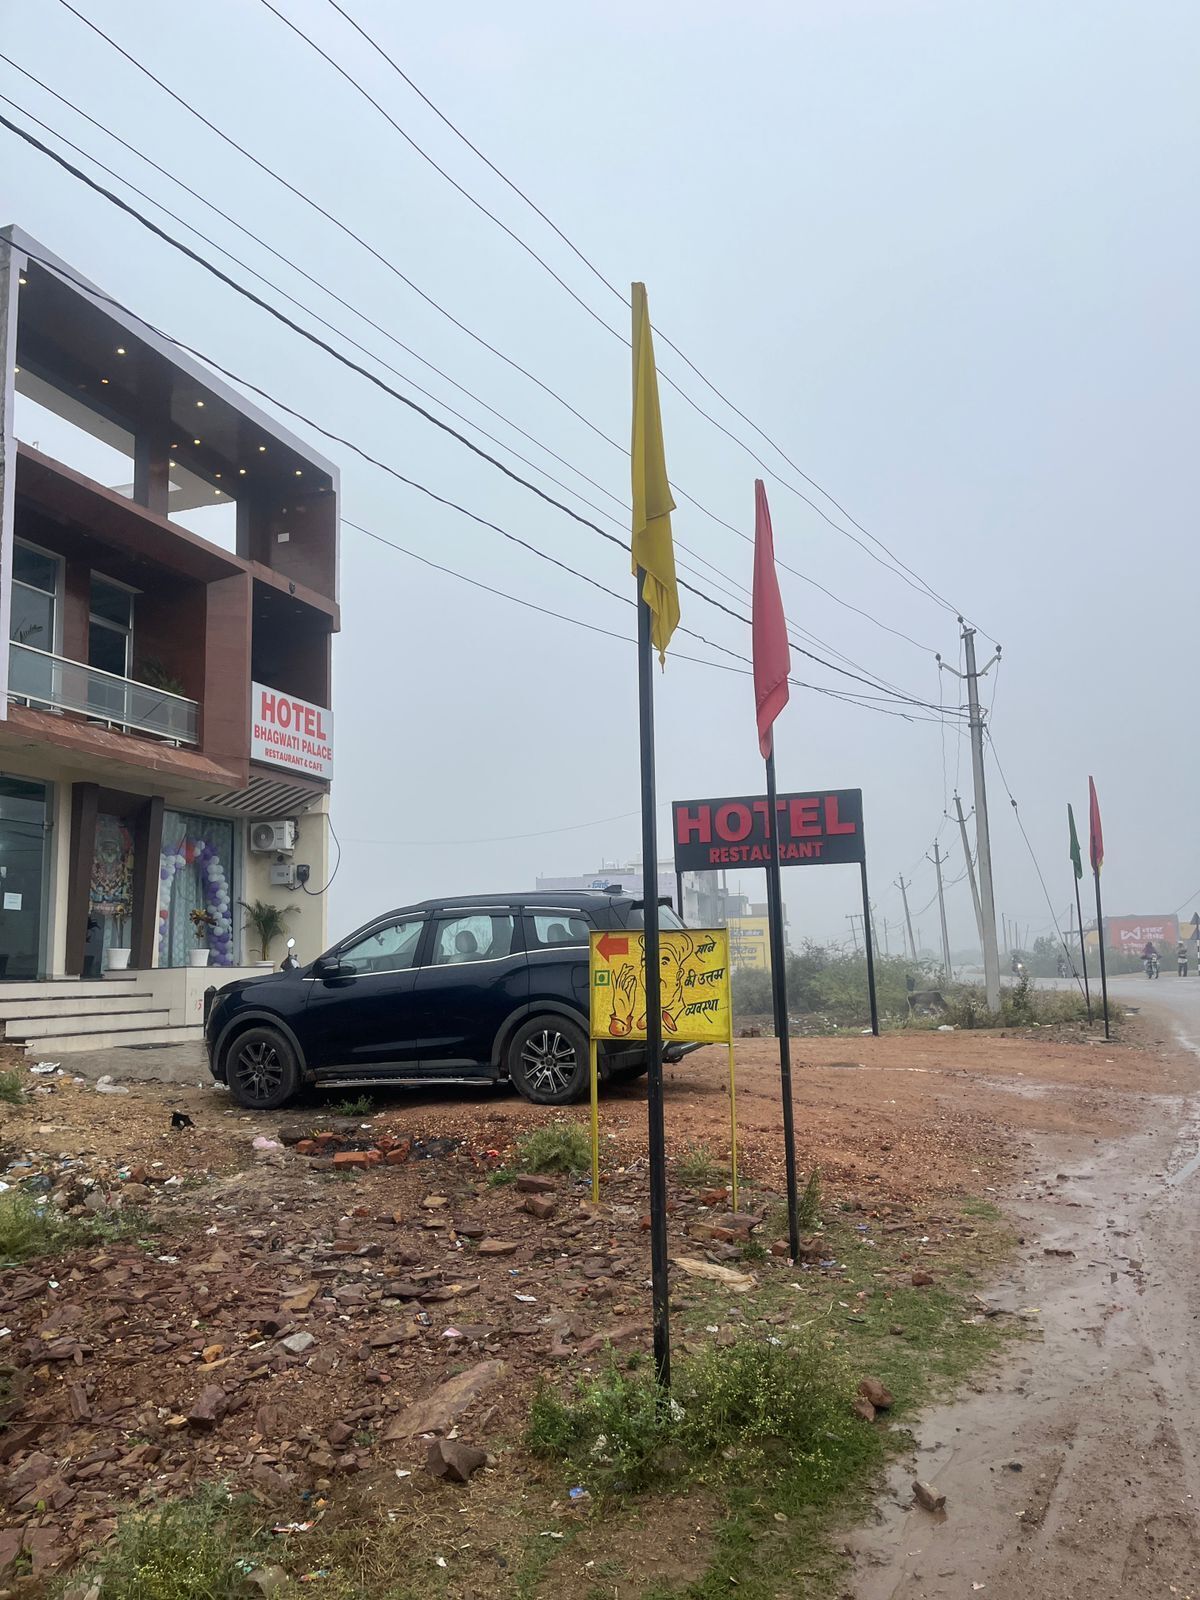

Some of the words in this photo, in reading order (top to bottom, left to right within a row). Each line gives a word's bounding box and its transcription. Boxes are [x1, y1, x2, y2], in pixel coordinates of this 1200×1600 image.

[261, 691, 327, 741] HOTEL
[254, 724, 300, 751] BHAGWATI
[302, 739, 332, 761] PALACE
[264, 747, 304, 766] RESTAURANT
[676, 795, 857, 845] HOTEL
[709, 841, 824, 864] RESTAURANT
[684, 968, 698, 988] की
[698, 967, 726, 988] उत्तम
